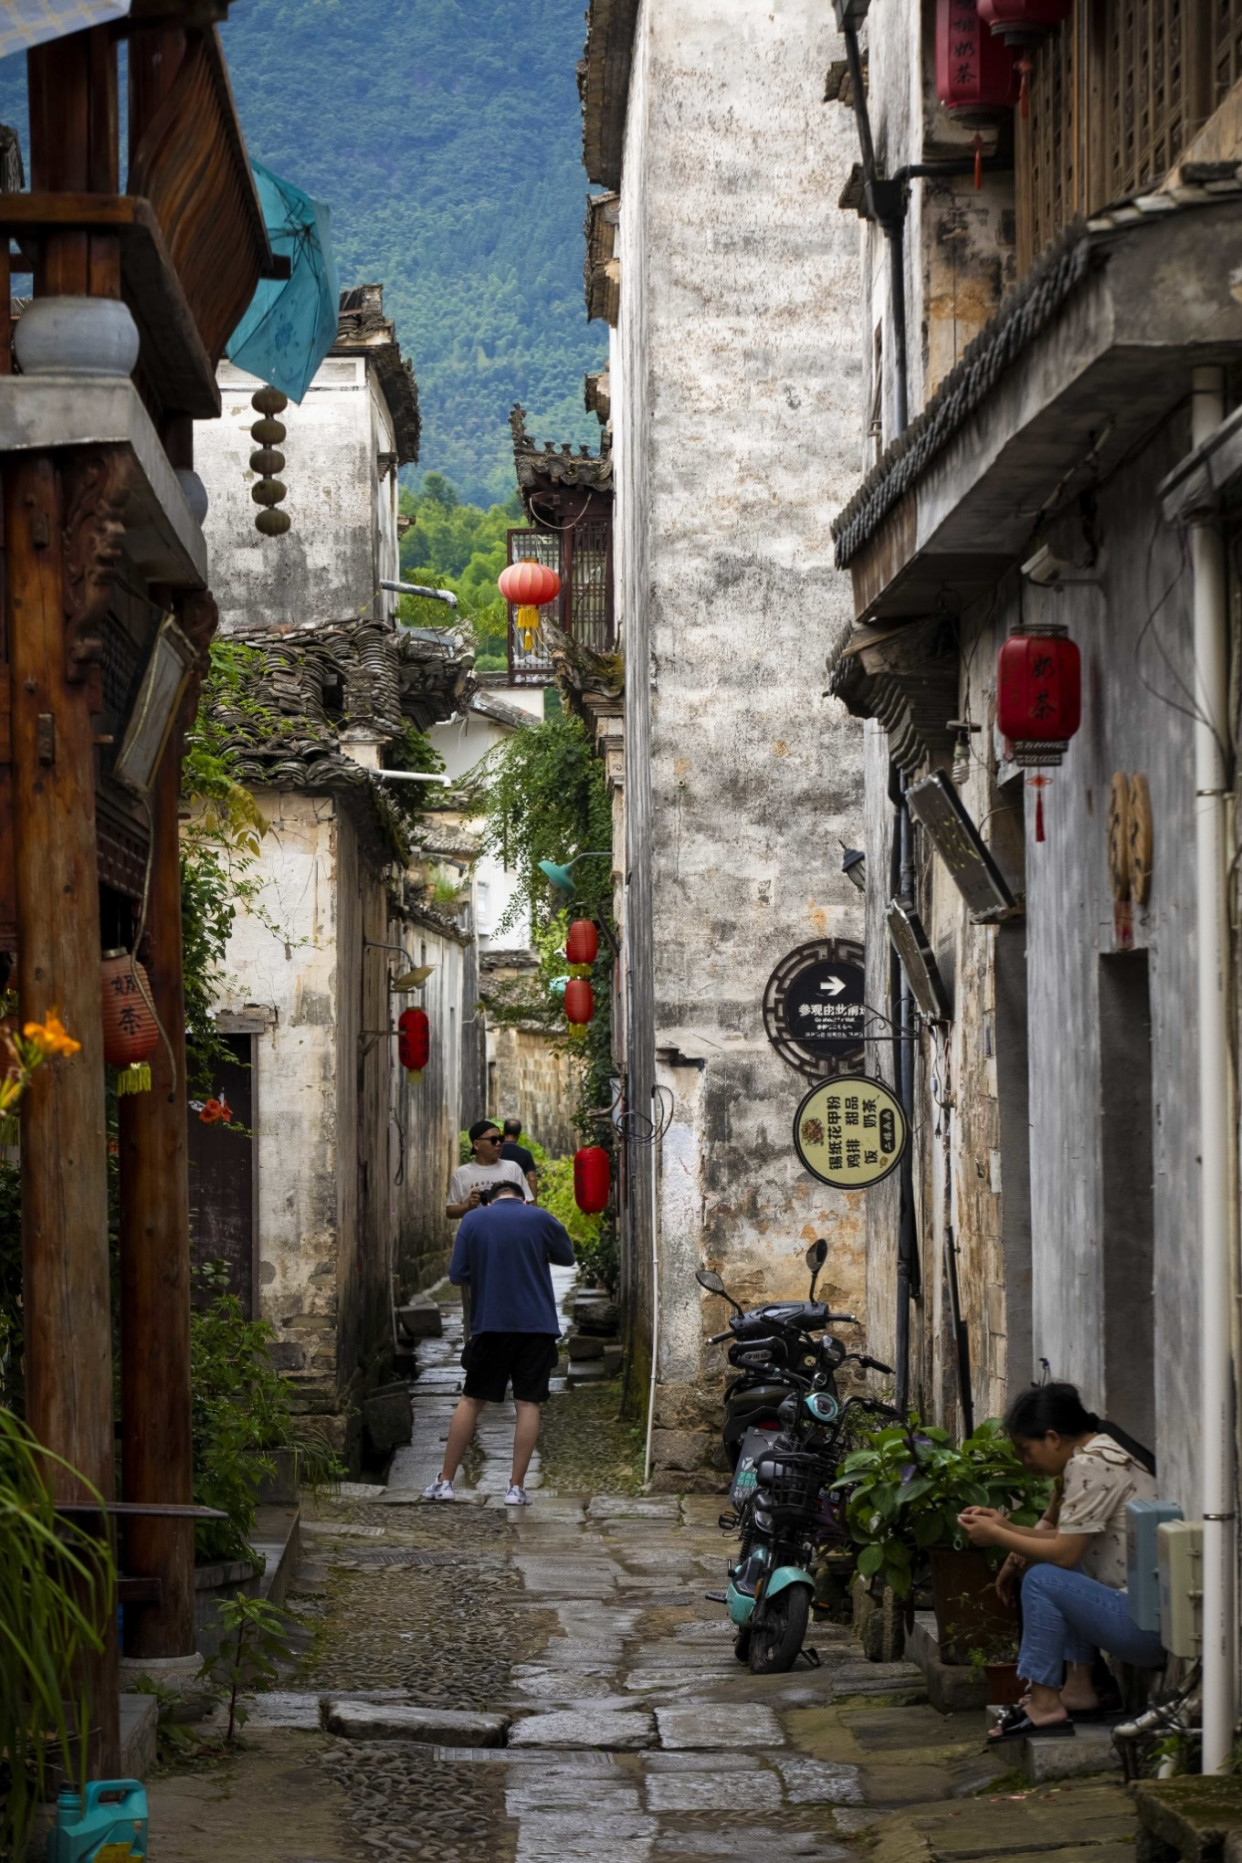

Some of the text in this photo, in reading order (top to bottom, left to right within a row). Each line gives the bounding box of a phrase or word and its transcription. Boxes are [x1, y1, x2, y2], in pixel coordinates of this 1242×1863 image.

[1031, 654, 1057, 720] 奶茶
[827, 1096, 843, 1170] 锡纸花甲粉
[844, 1096, 860, 1168] 鸡排 甜品
[862, 1098, 878, 1165] 饭 奶茶
